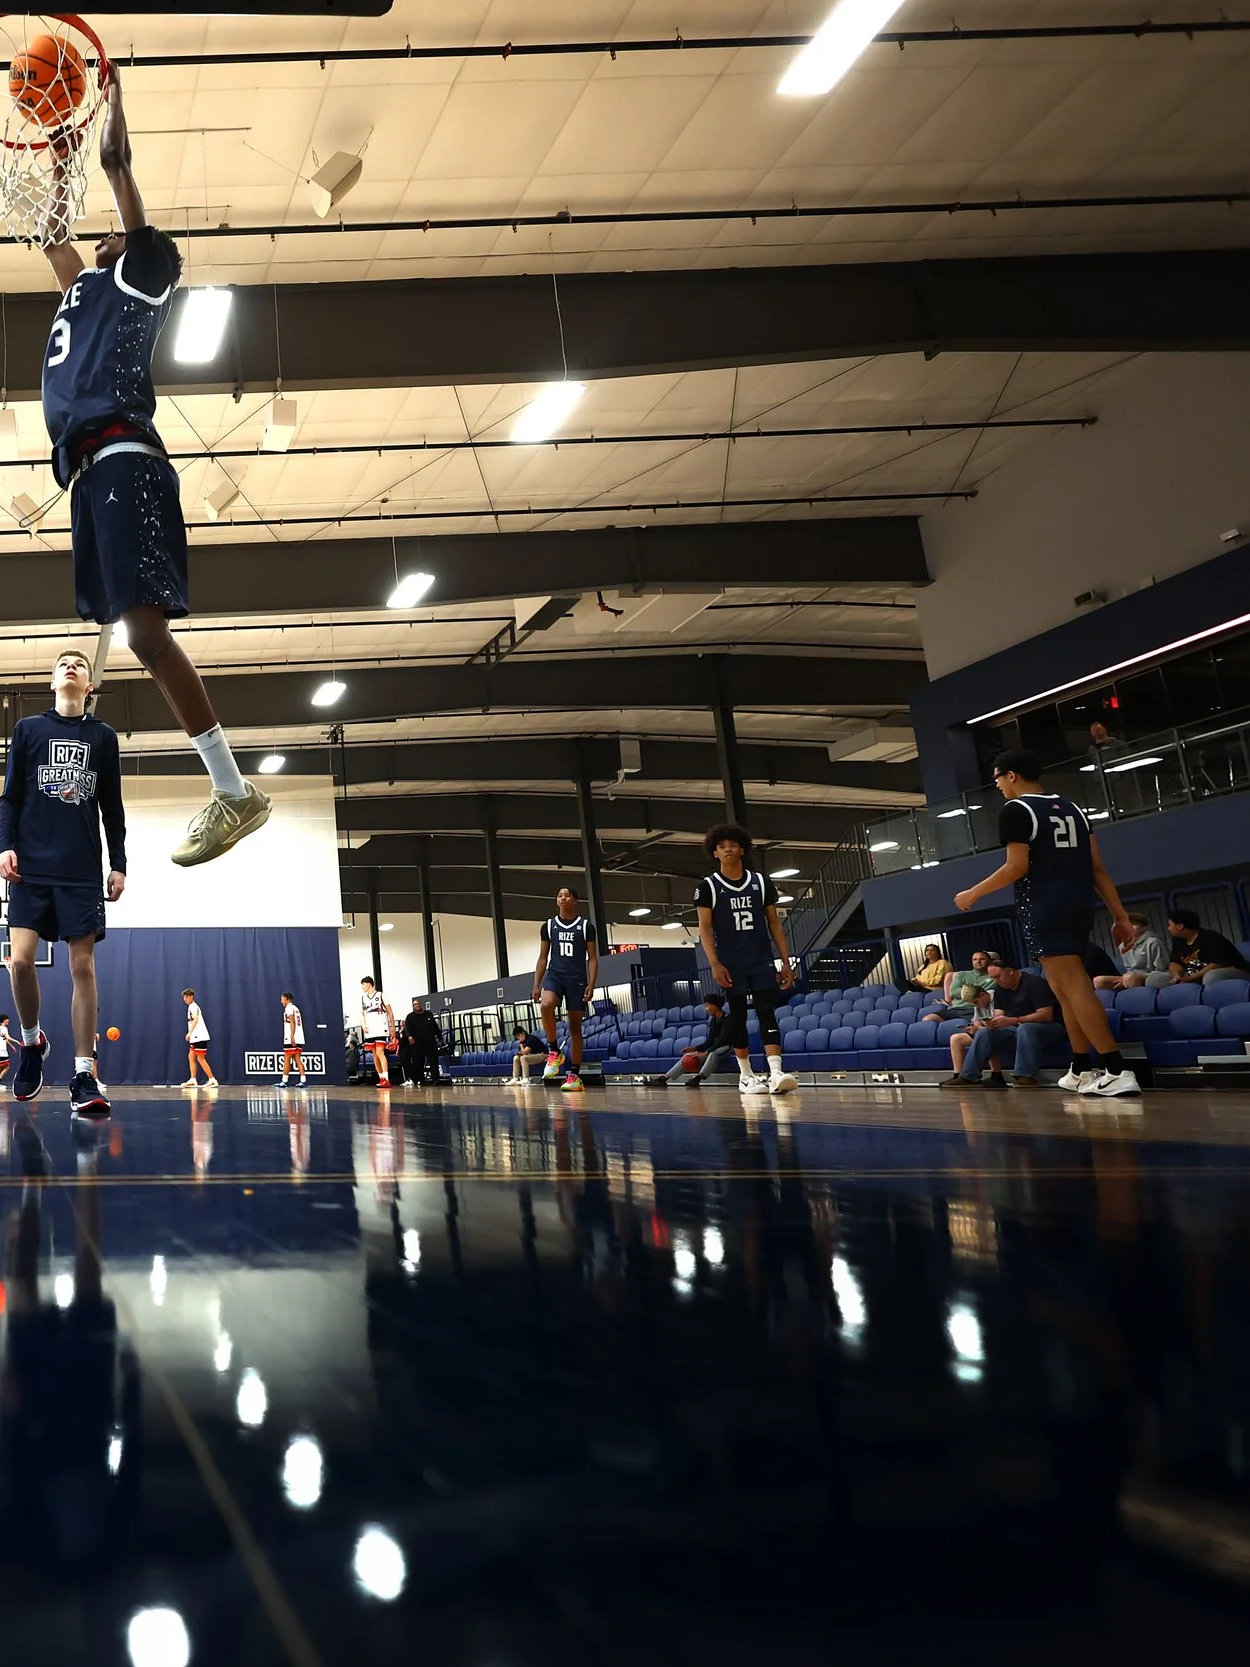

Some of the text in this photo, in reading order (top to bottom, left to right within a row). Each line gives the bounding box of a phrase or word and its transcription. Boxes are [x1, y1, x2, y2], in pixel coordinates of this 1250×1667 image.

[56, 746, 84, 765] RIZE
[1049, 815, 1078, 848] 21
[730, 896, 753, 910] RIZE
[732, 911, 754, 931] 12
[558, 931, 575, 942] RIZE
[559, 942, 574, 957] 10
[248, 1055, 274, 1071] RIZE
